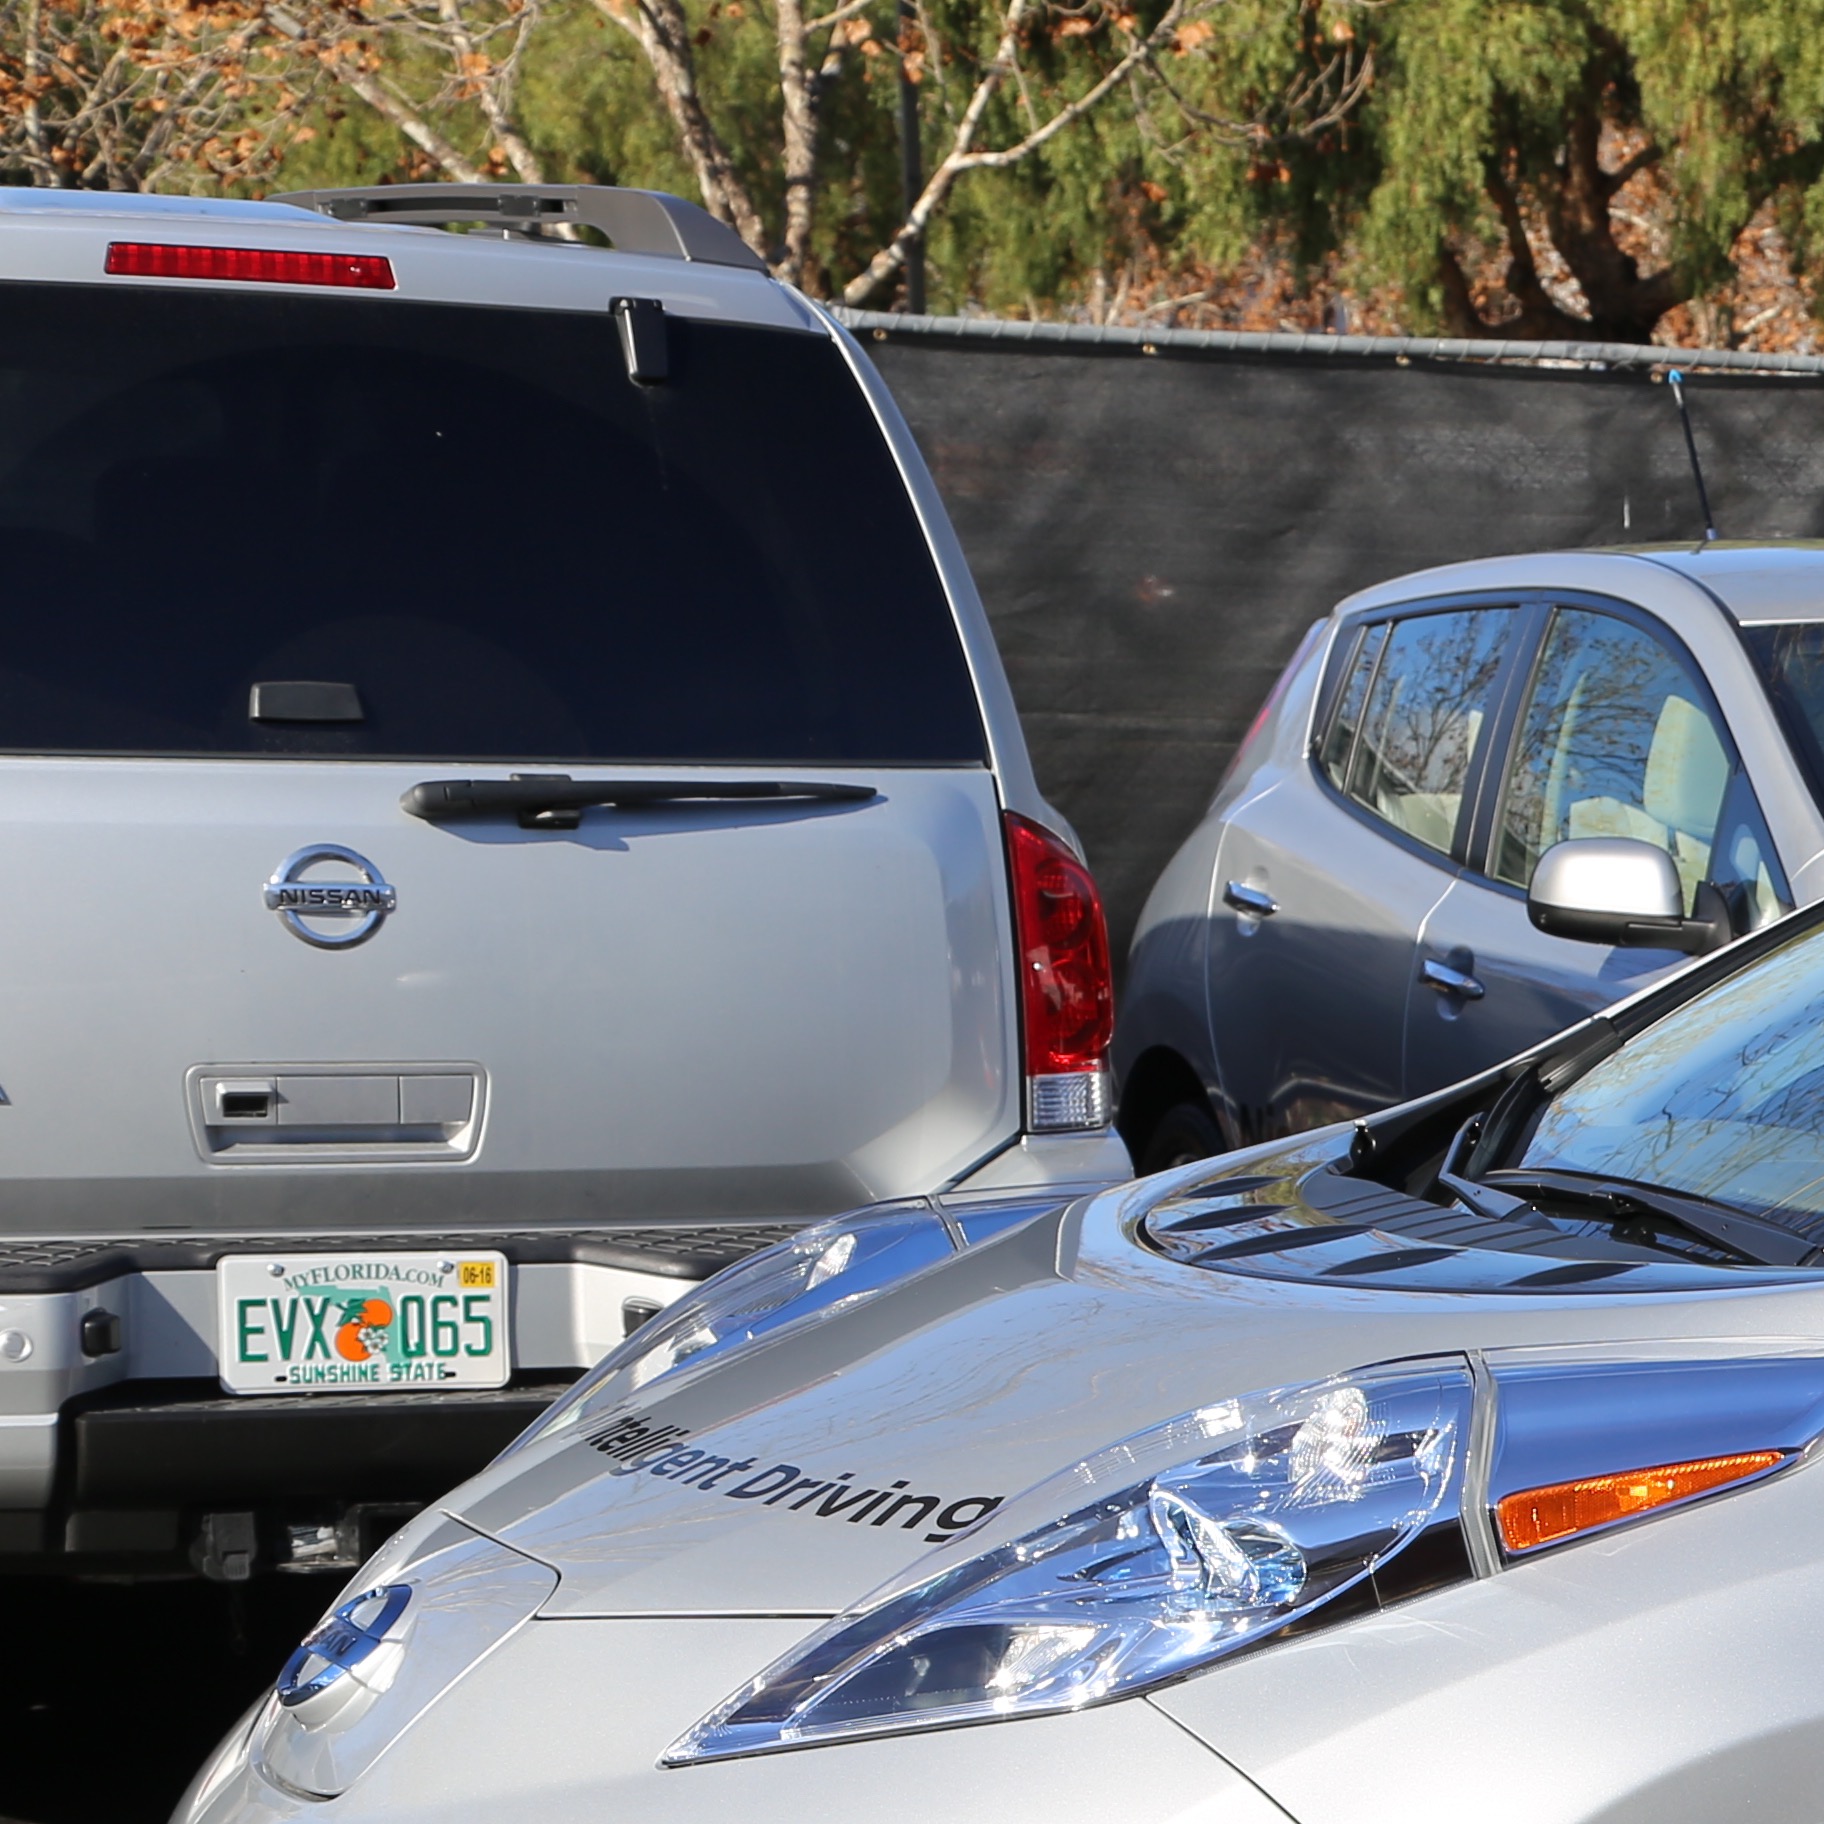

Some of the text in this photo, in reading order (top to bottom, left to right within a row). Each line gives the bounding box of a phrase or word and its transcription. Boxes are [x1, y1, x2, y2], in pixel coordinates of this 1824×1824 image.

[280, 888, 381, 904] NISSAN
[284, 1263, 444, 1290] MYFLORIDA.COM
[462, 1266, 492, 1284] 06-16
[237, 1294, 493, 1363] EVX Q65
[289, 1362, 447, 1384] SUNSHINE STATE
[584, 1412, 1006, 1544] ntelligent Driving
